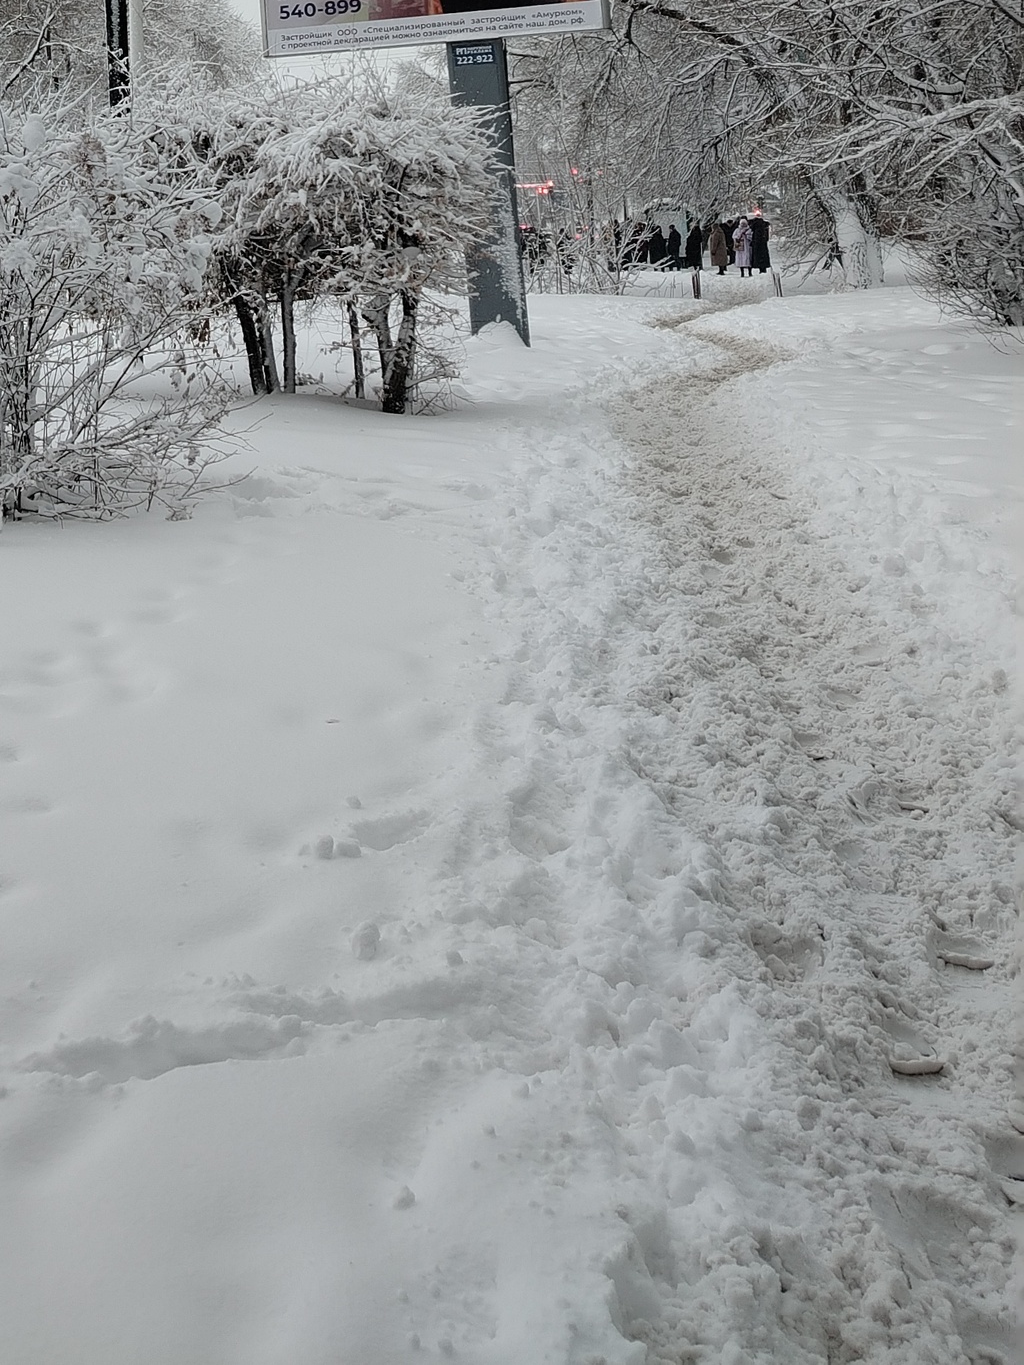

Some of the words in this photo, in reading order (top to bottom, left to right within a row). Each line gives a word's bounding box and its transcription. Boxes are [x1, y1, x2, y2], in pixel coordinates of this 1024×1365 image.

[281, 31, 332, 42] Застройщик
[337, 28, 358, 36] ООО
[363, 18, 465, 34] «Специализированный
[471, 14, 526, 26] застройщик
[531, 9, 585, 20] «Амурком»,
[288, 38, 332, 49] проектной
[392, 31, 421, 39] можно
[423, 26, 484, 37] ознакомиться
[498, 22, 524, 30] сайте
[456, 54, 494, 64] 222-922
